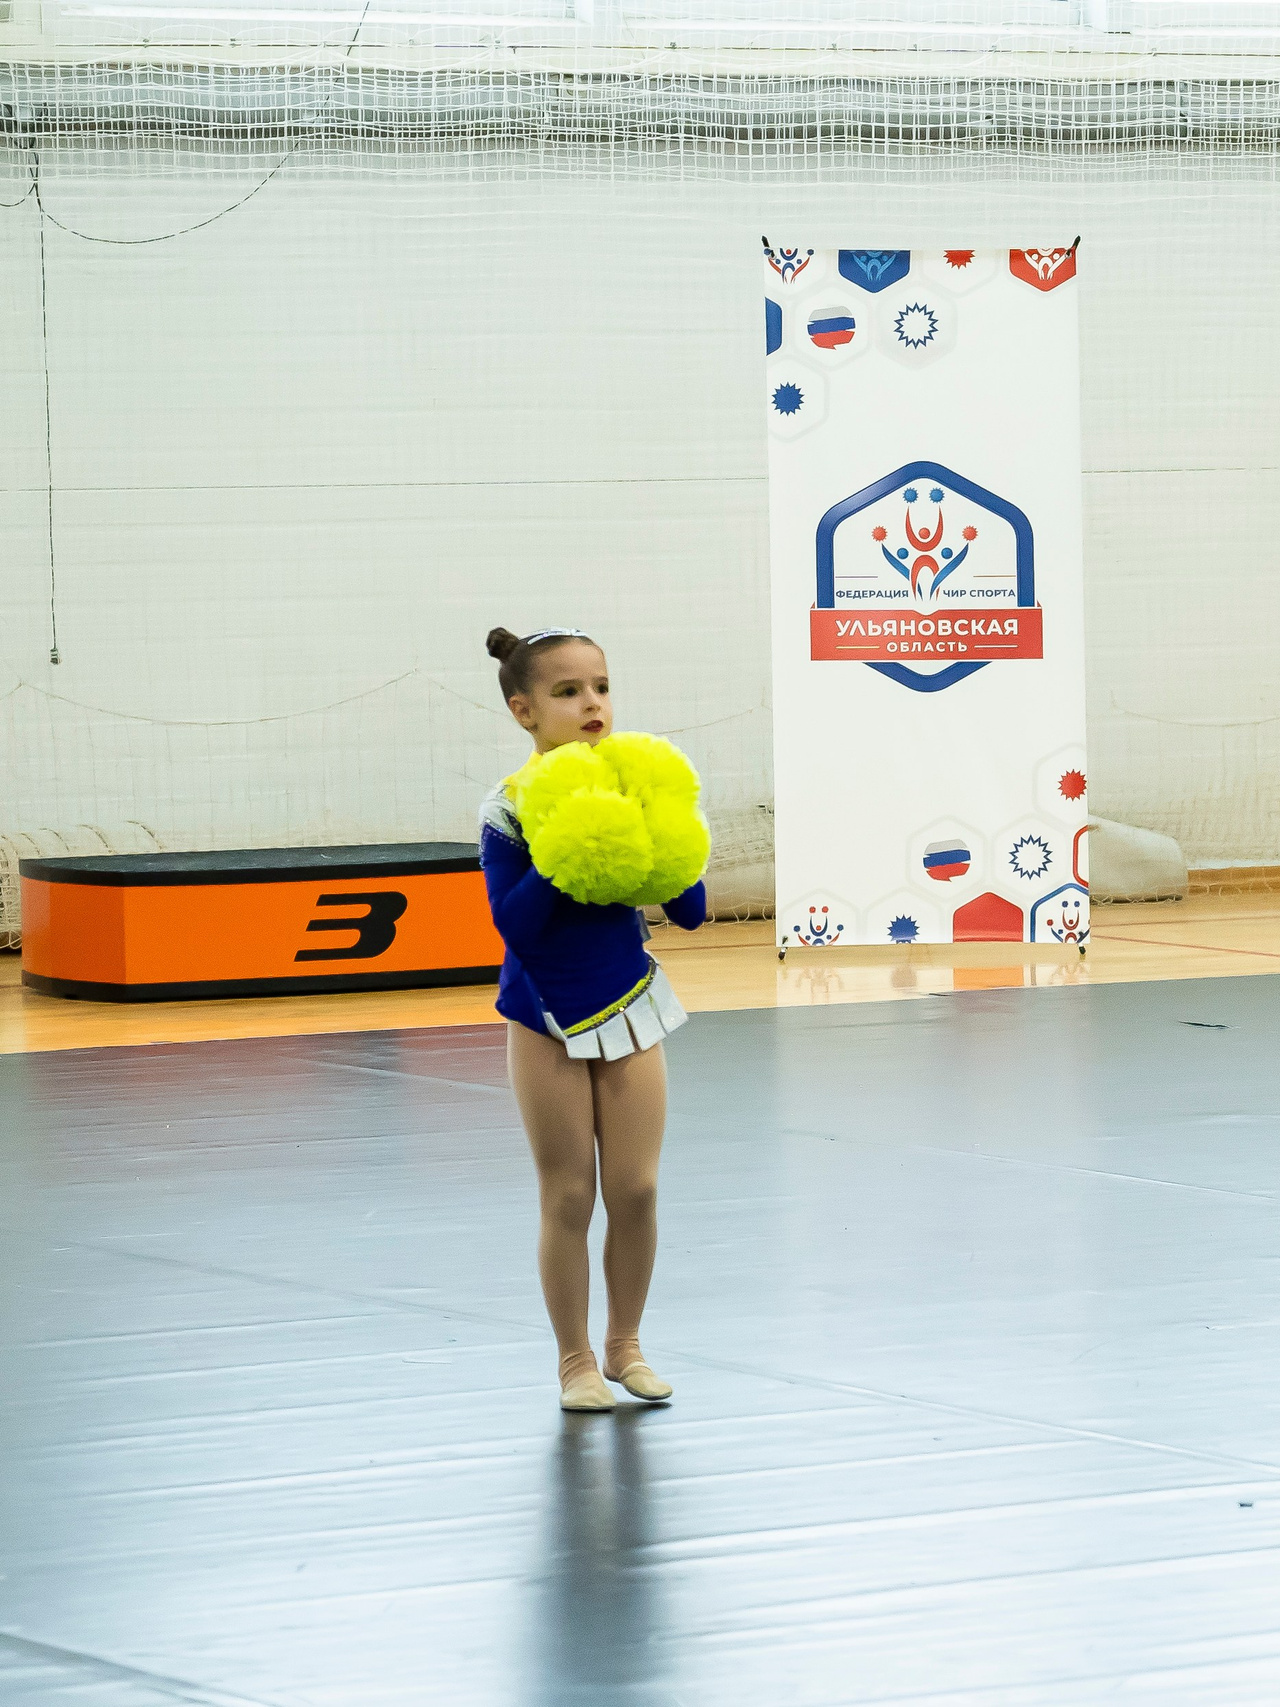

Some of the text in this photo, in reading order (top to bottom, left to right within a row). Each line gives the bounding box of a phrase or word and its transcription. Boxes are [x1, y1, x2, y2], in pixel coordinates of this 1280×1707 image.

[835, 588, 1016, 600] ФЕДЕРАЦИЯ ЧИР СПОРТА
[835, 619, 1019, 637] УЛЬЯНОВСКАЯ
[886, 641, 968, 653] ОБЛАСТЬ
[293, 891, 408, 963] 3
